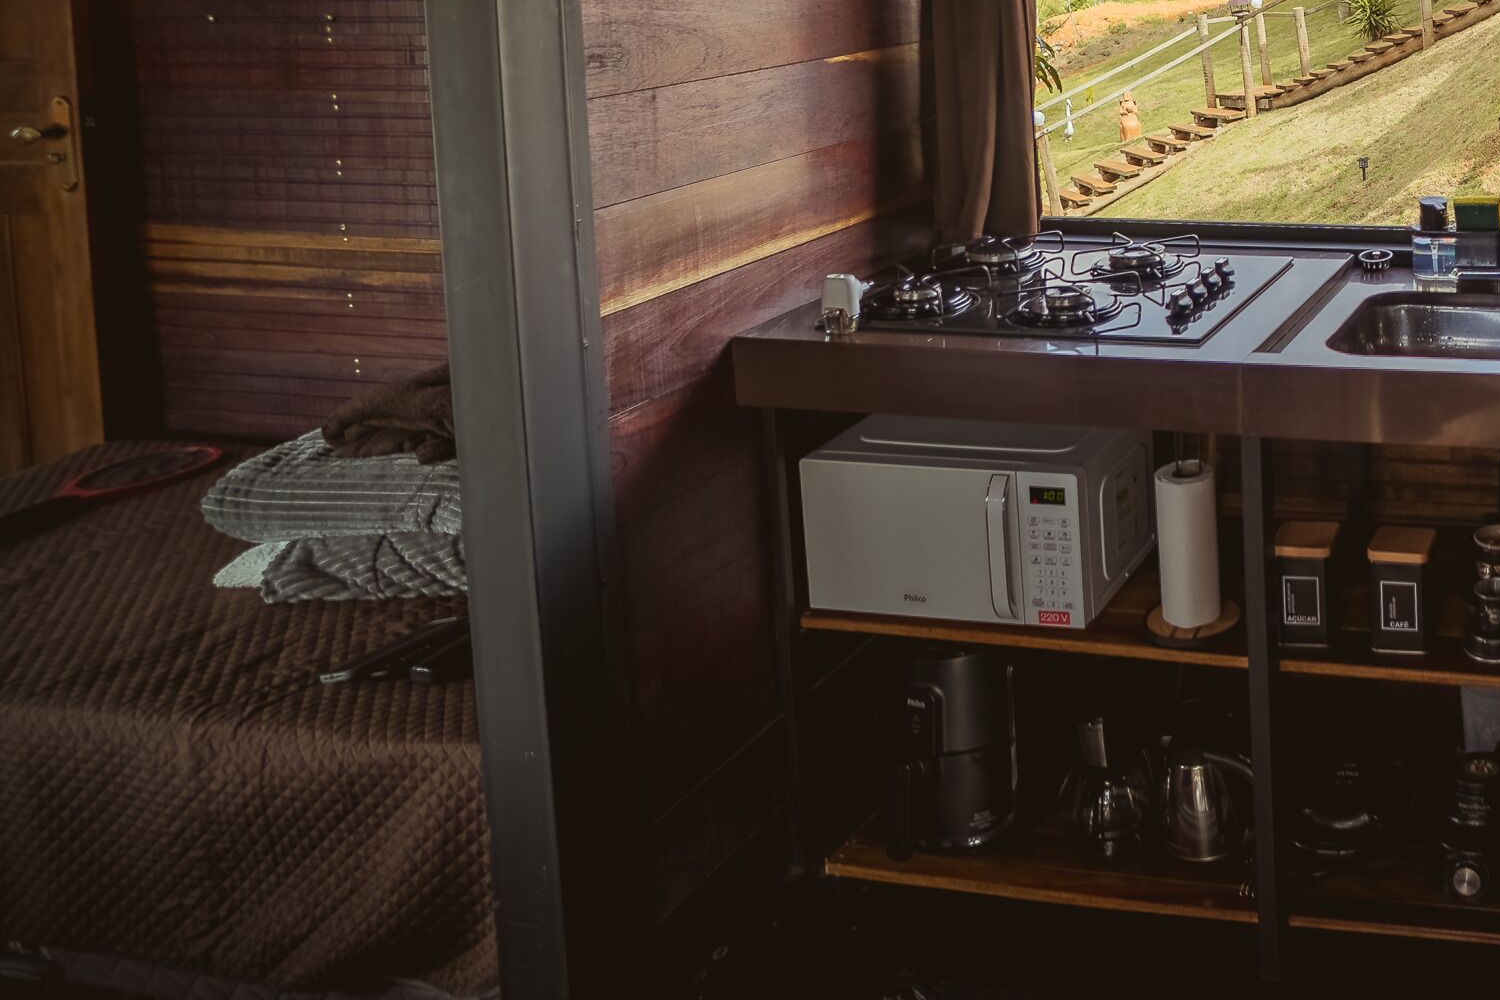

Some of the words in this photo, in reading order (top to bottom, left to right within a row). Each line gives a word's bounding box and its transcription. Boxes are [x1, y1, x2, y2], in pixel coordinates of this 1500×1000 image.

[903, 593, 927, 602] Philco
[1040, 612, 1060, 622] 220
[1060, 613, 1068, 623] V
[1389, 619, 1409, 628] CAFÉ
